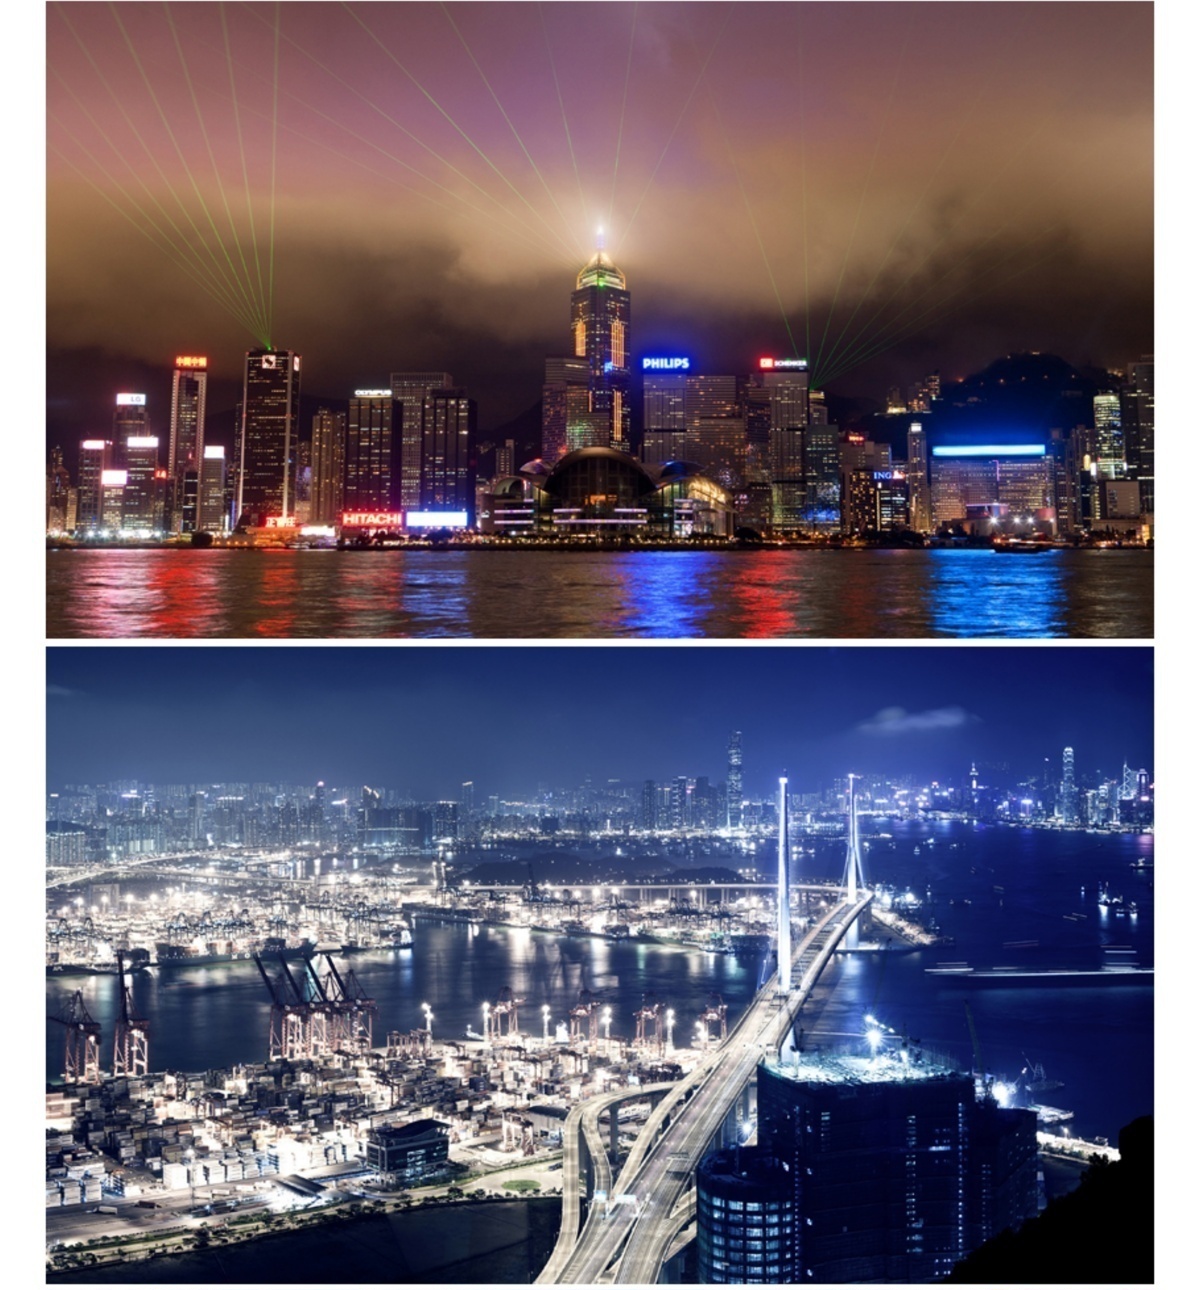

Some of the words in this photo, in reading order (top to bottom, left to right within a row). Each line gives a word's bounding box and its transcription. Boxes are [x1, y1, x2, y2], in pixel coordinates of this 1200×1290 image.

[643, 358, 690, 369] PHILIPS
[873, 471, 892, 480] ING
[343, 513, 402, 525] HITACHI
